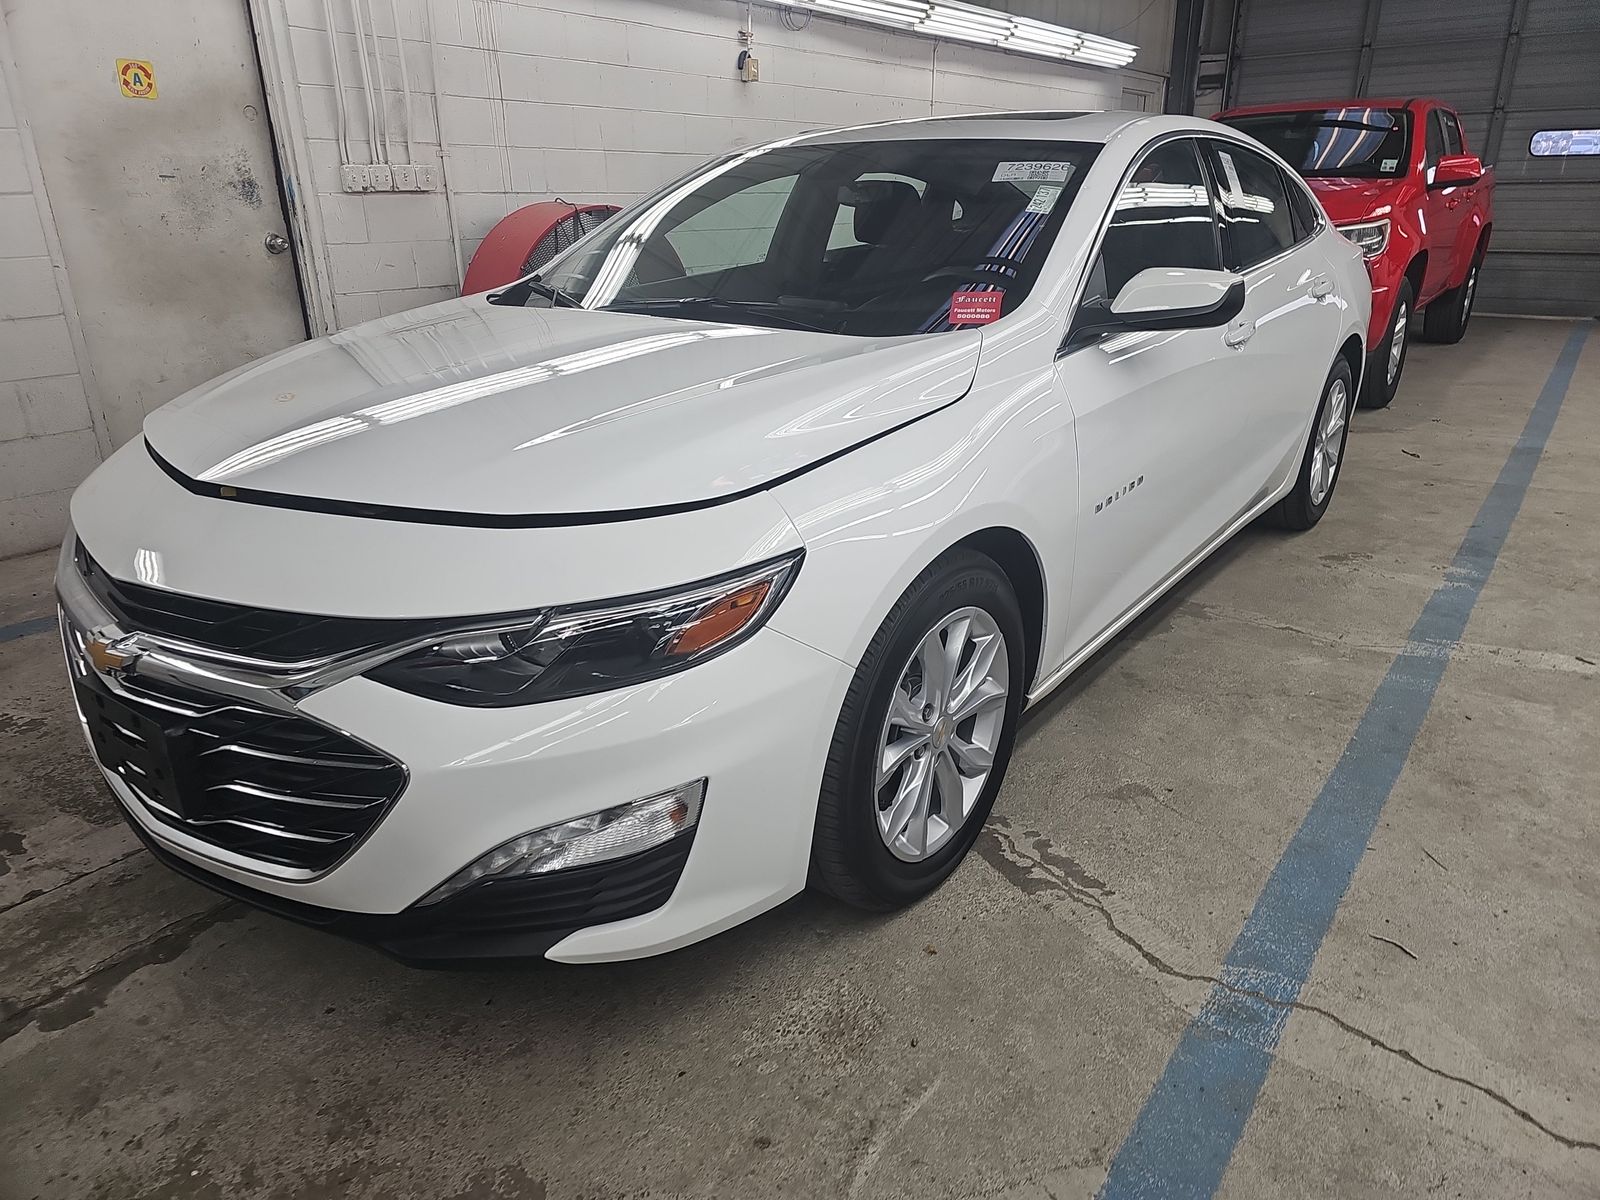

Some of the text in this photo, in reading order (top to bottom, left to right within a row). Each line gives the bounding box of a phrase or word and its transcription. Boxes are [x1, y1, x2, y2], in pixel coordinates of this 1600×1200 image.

[133, 72, 144, 87] A
[1007, 163, 1071, 171] 7239626
[955, 295, 997, 304] Faucett
